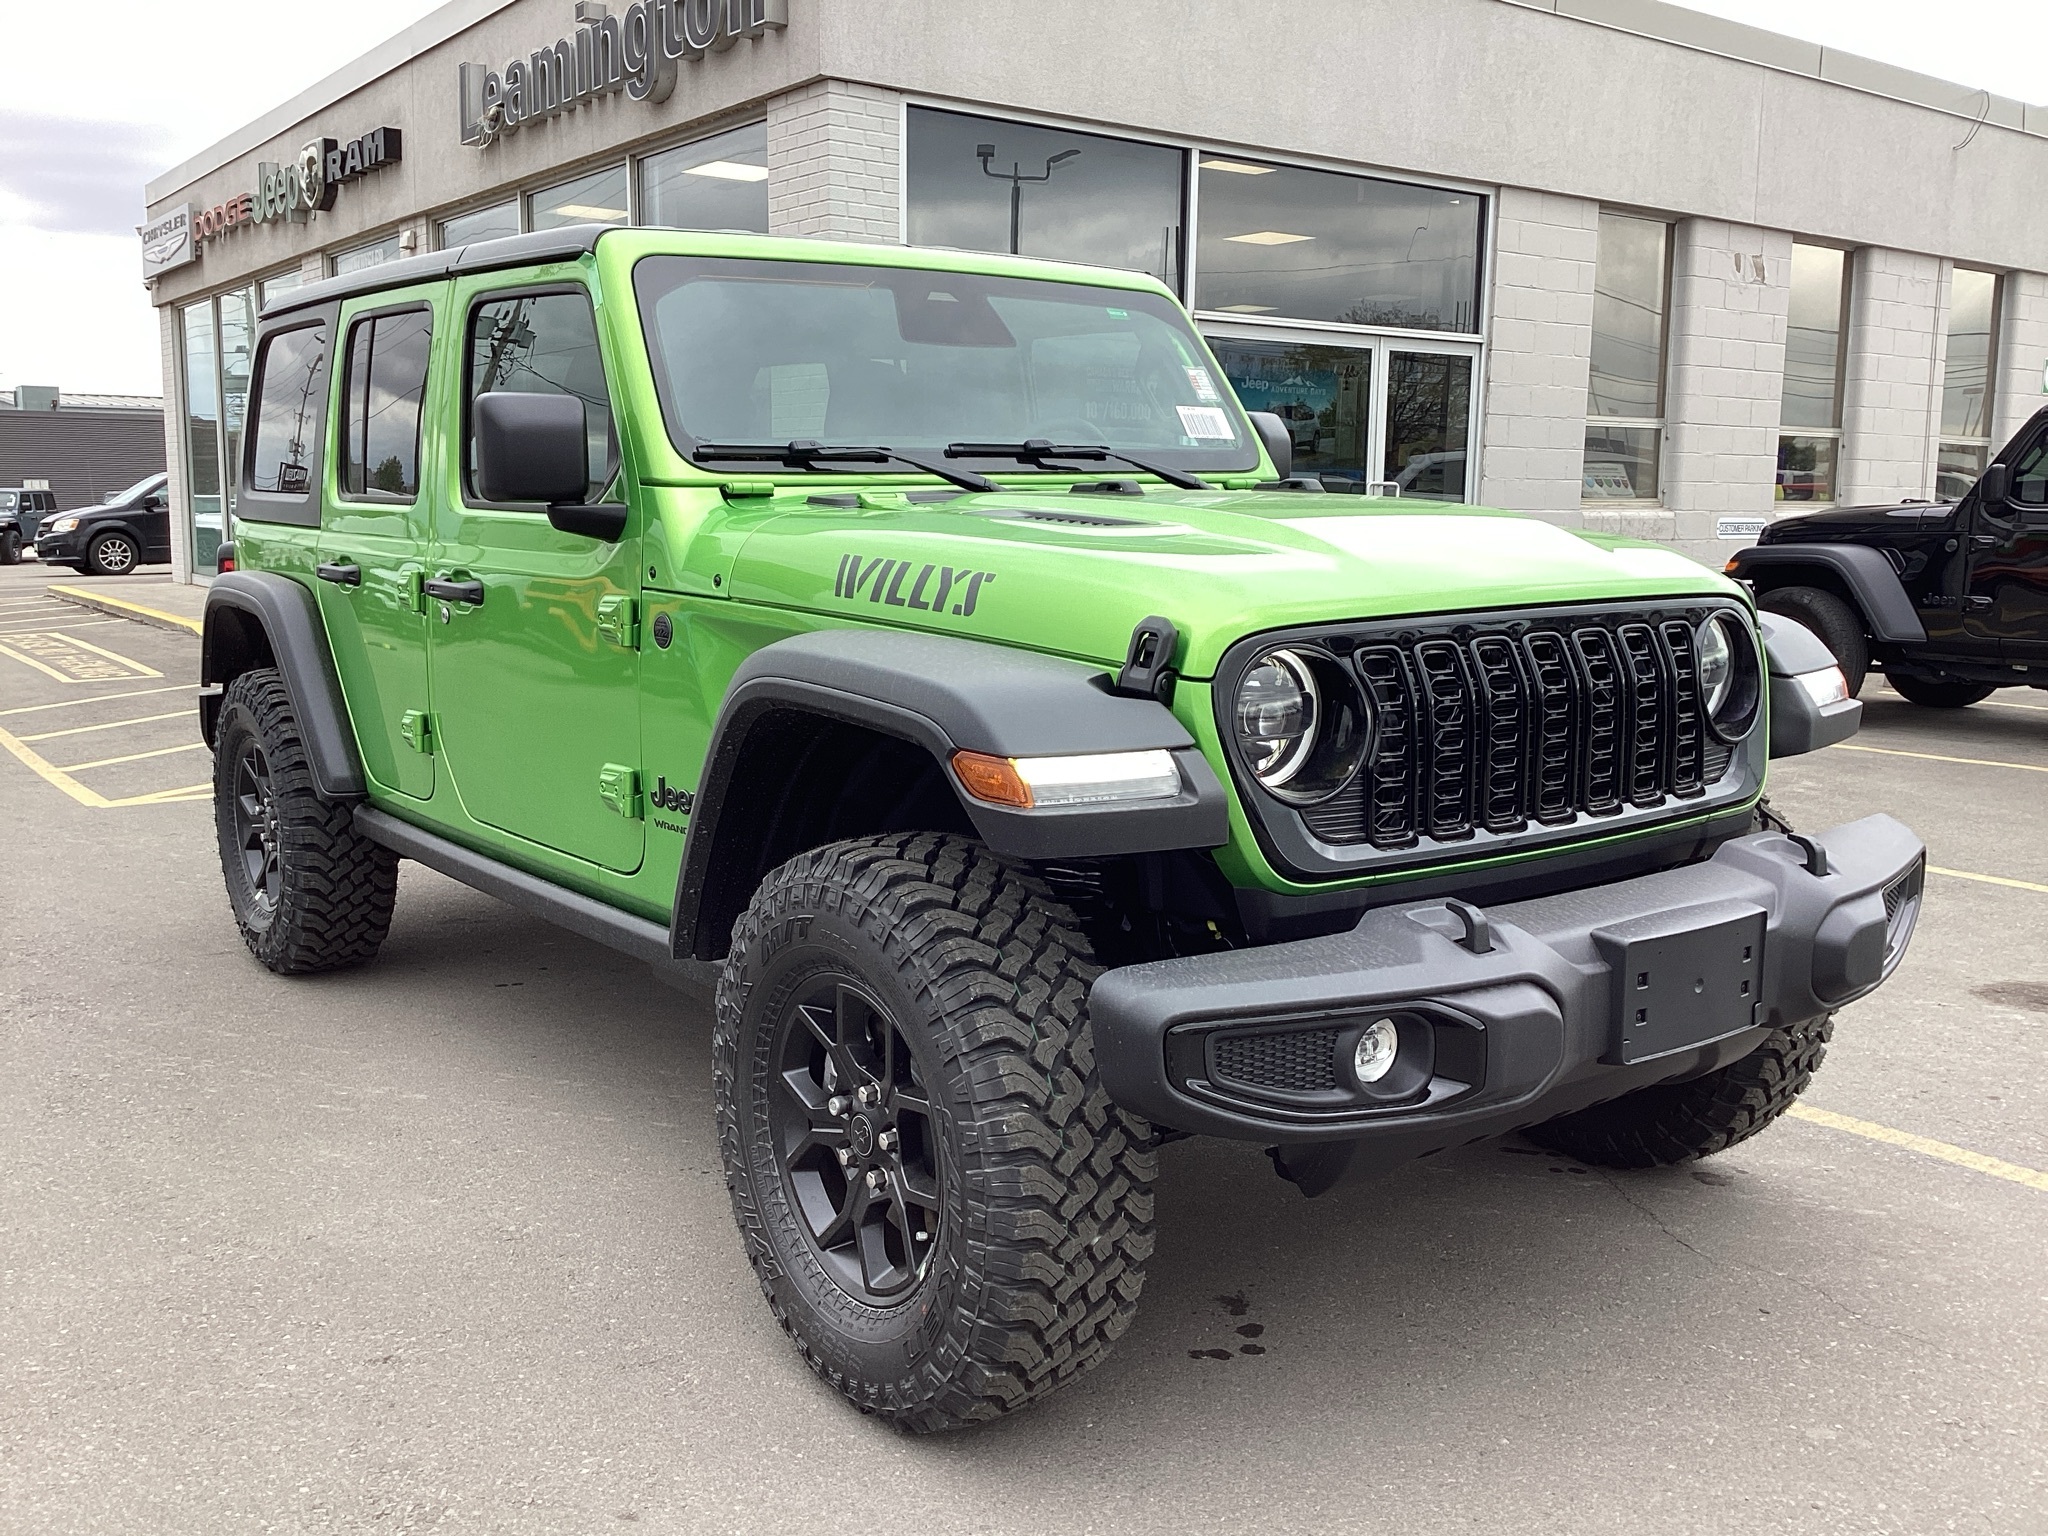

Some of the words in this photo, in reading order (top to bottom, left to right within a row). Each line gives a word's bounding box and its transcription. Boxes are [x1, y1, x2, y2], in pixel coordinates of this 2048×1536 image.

[326, 127, 396, 184] RAM
[252, 162, 301, 224] Jeep
[142, 213, 188, 246] CHRYSLER
[194, 193, 250, 242] DODGE
[1241, 376, 1269, 392] Jeep
[1270, 386, 1309, 395] ADVENTURE
[1718, 524, 1744, 533] CUSTOMER
[834, 553, 997, 617] WILLYS
[1922, 592, 1957, 607] Jeep
[761, 914, 814, 966] M/T
